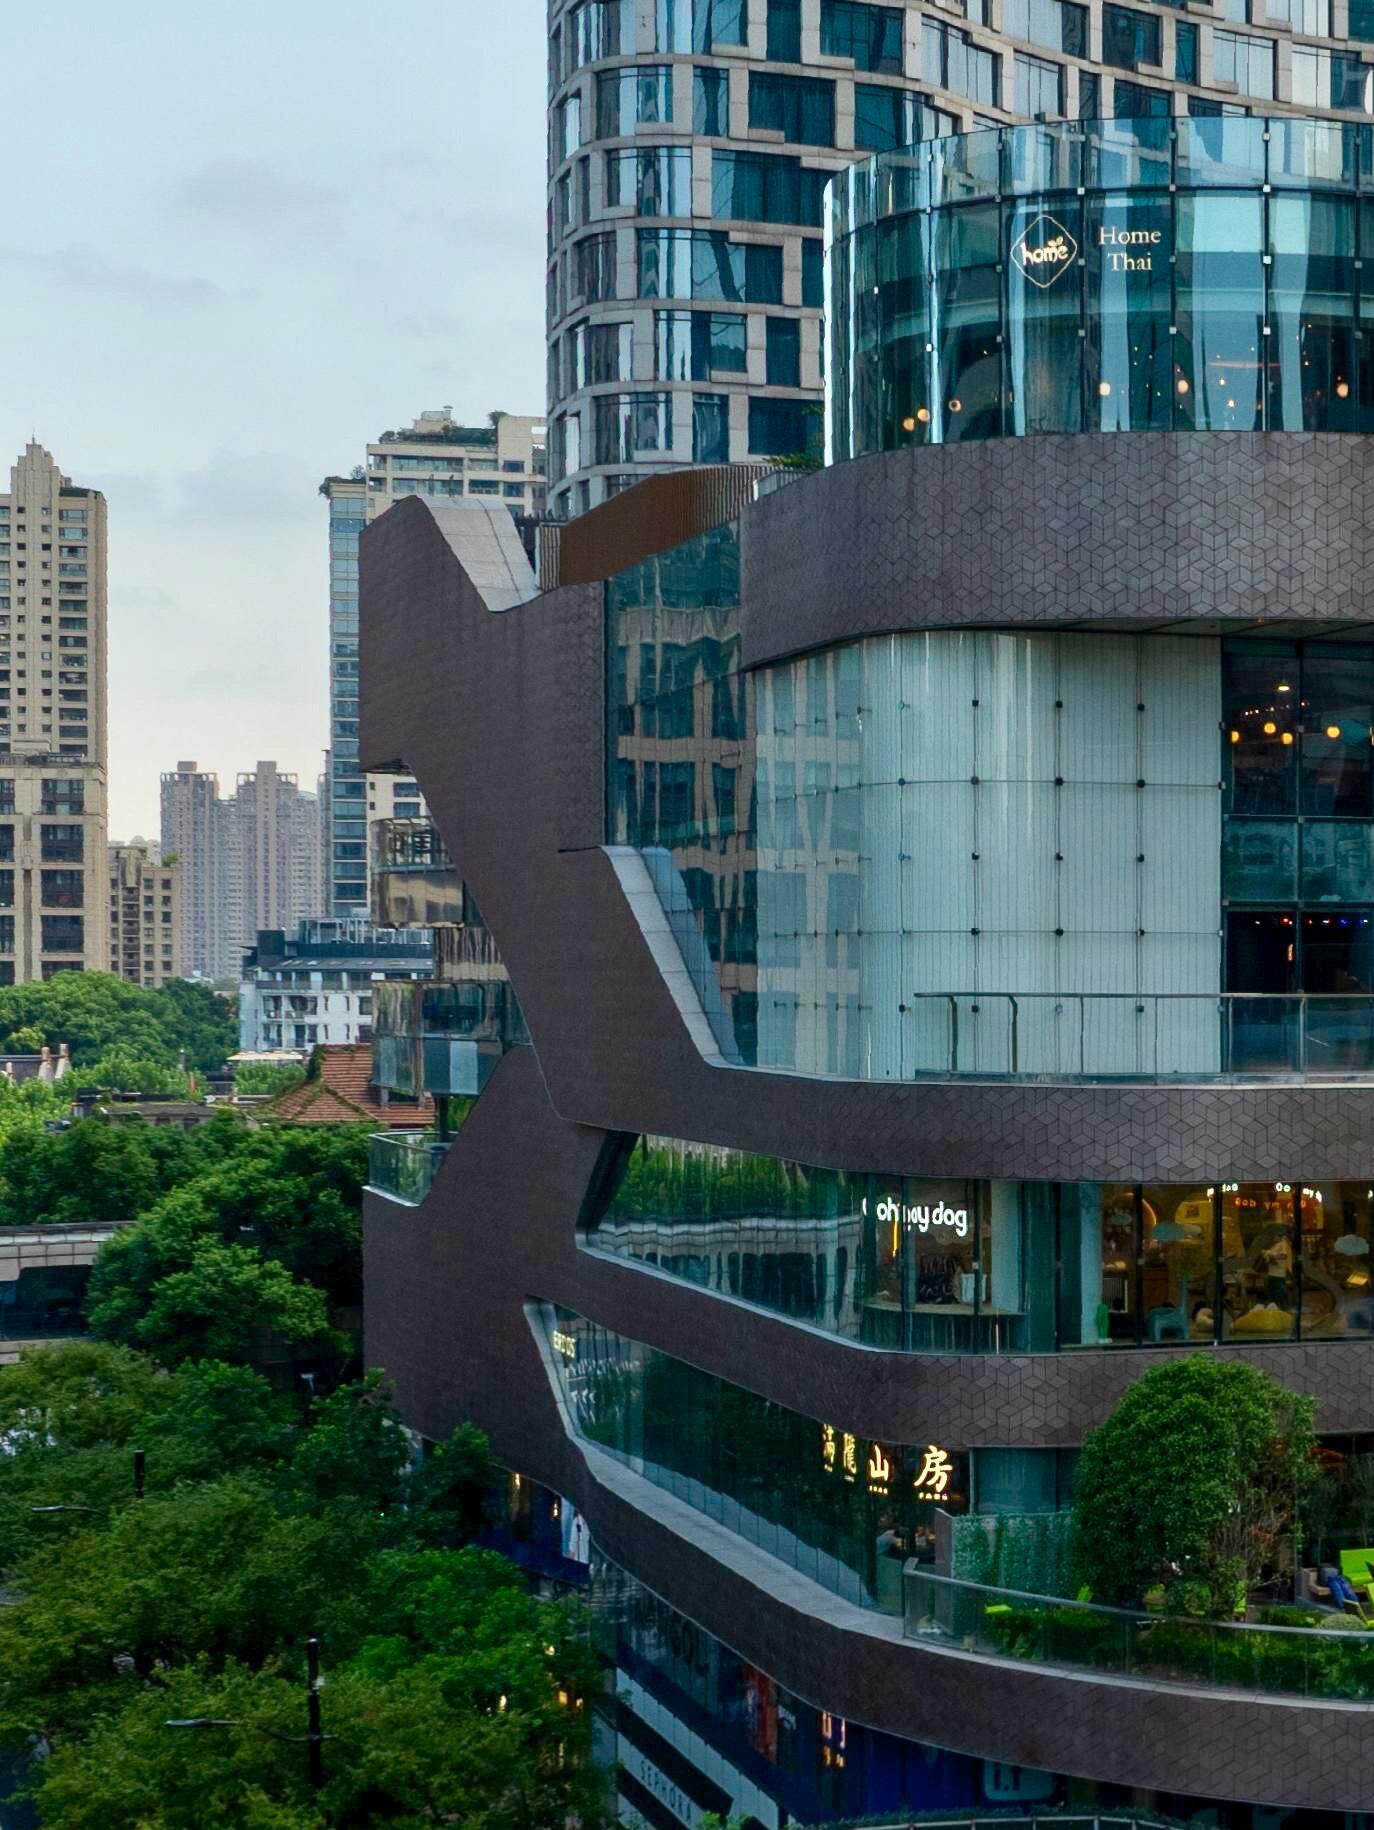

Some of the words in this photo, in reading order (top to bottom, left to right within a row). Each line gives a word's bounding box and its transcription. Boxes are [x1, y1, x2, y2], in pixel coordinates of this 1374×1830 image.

[1099, 226, 1161, 245] Home
[1020, 241, 1069, 266] home
[1107, 252, 1152, 272] Thai
[932, 1200, 967, 1236] dog
